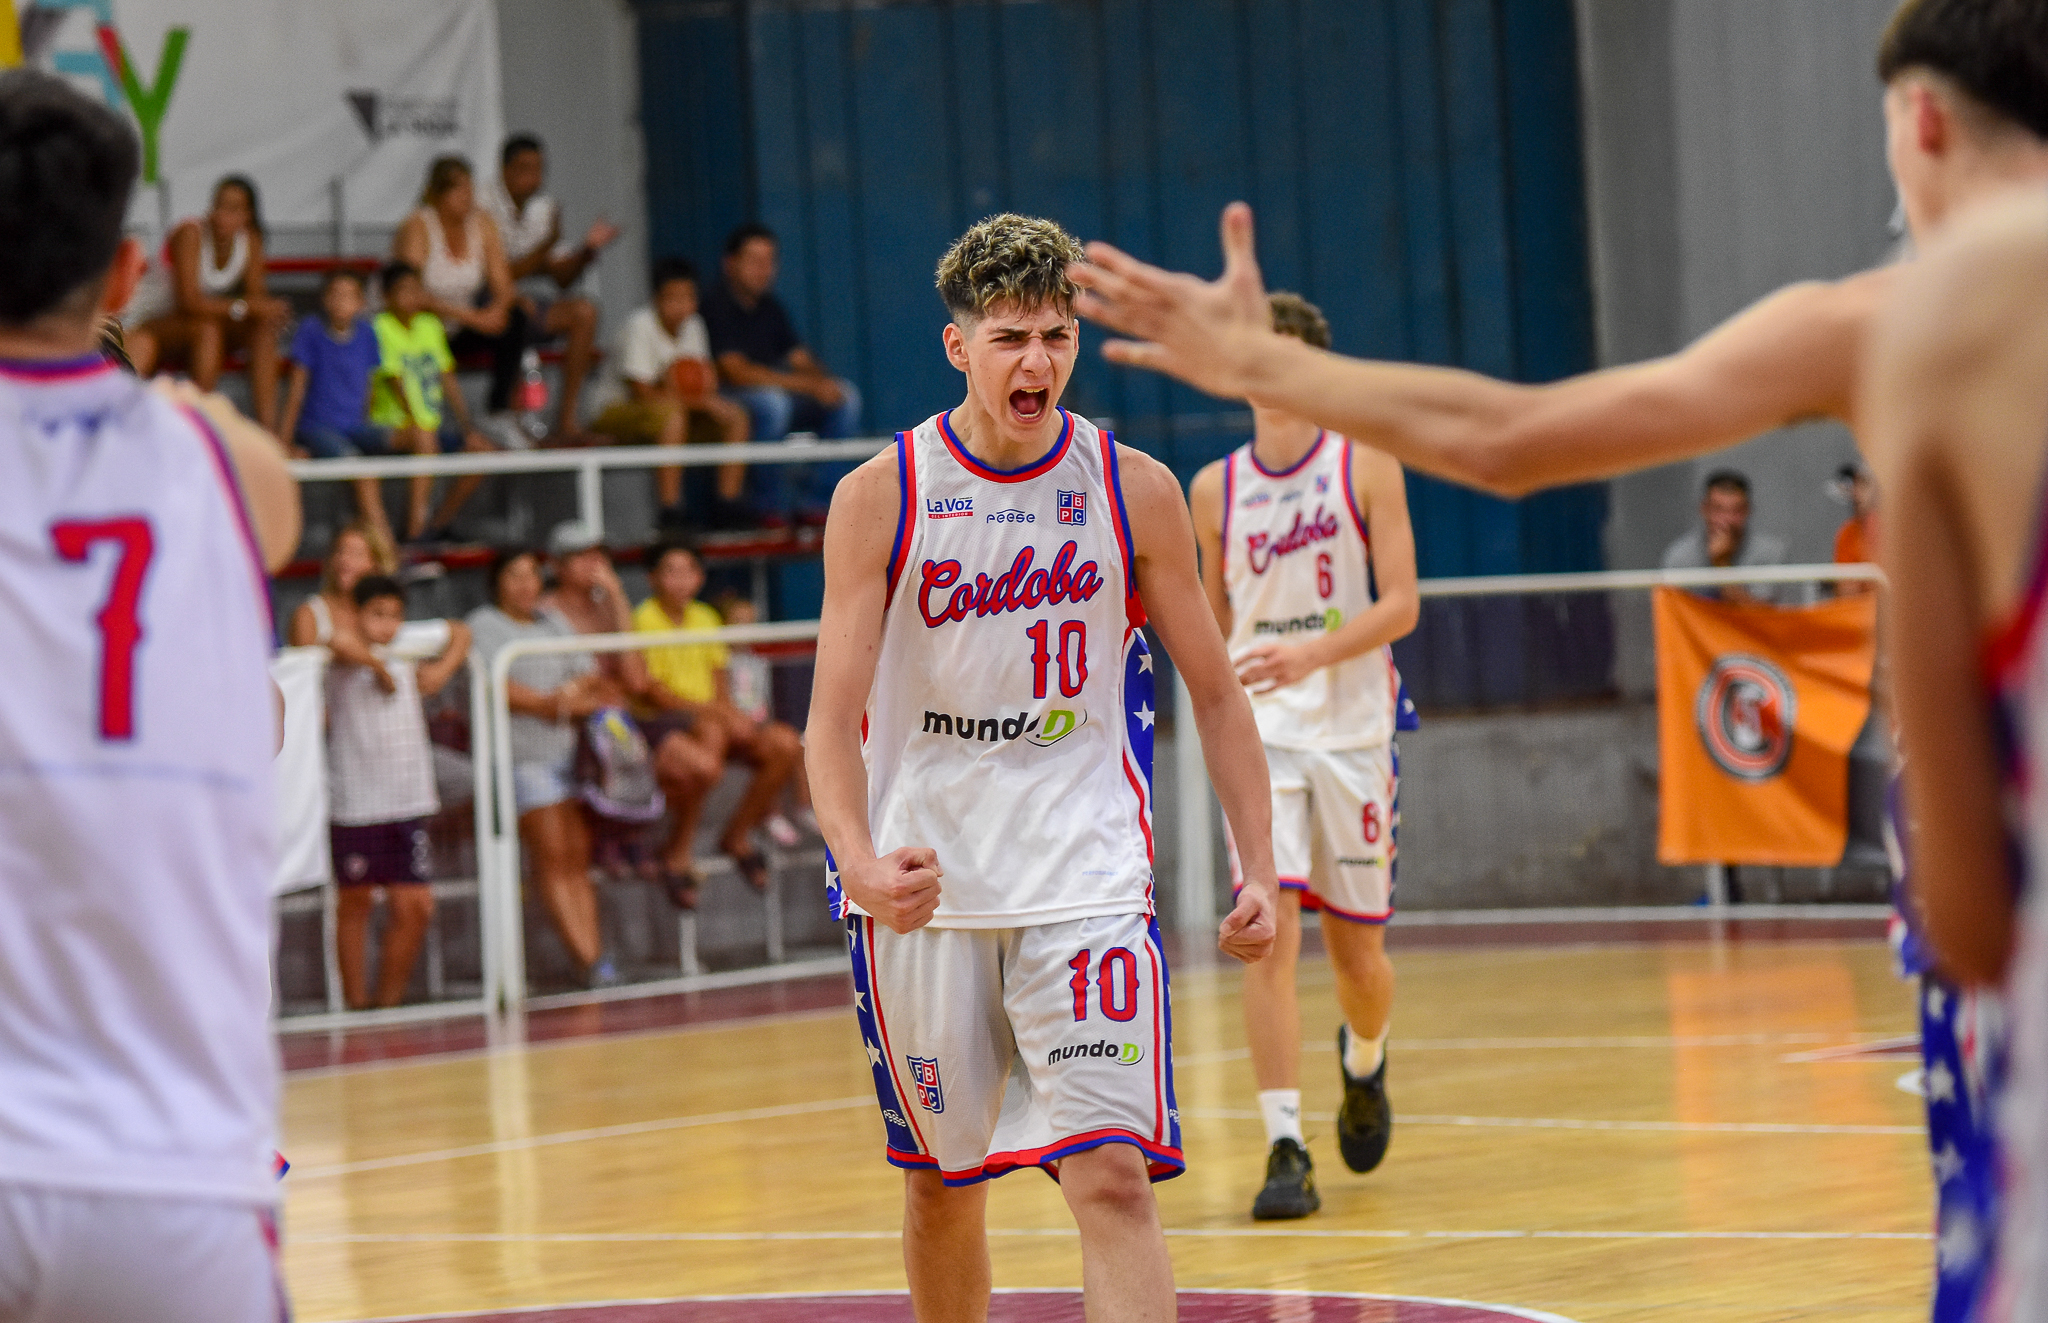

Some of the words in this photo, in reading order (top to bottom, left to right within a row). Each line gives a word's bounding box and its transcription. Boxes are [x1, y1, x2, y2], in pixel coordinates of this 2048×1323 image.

[926, 498, 944, 513] La
[944, 498, 974, 512] Voz
[918, 540, 1104, 628] Cordoba
[1316, 553, 1333, 600] 6
[50, 517, 153, 741] 7
[1026, 619, 1088, 699] 10
[1362, 801, 1380, 844] 6
[1068, 946, 1140, 1023] 10
